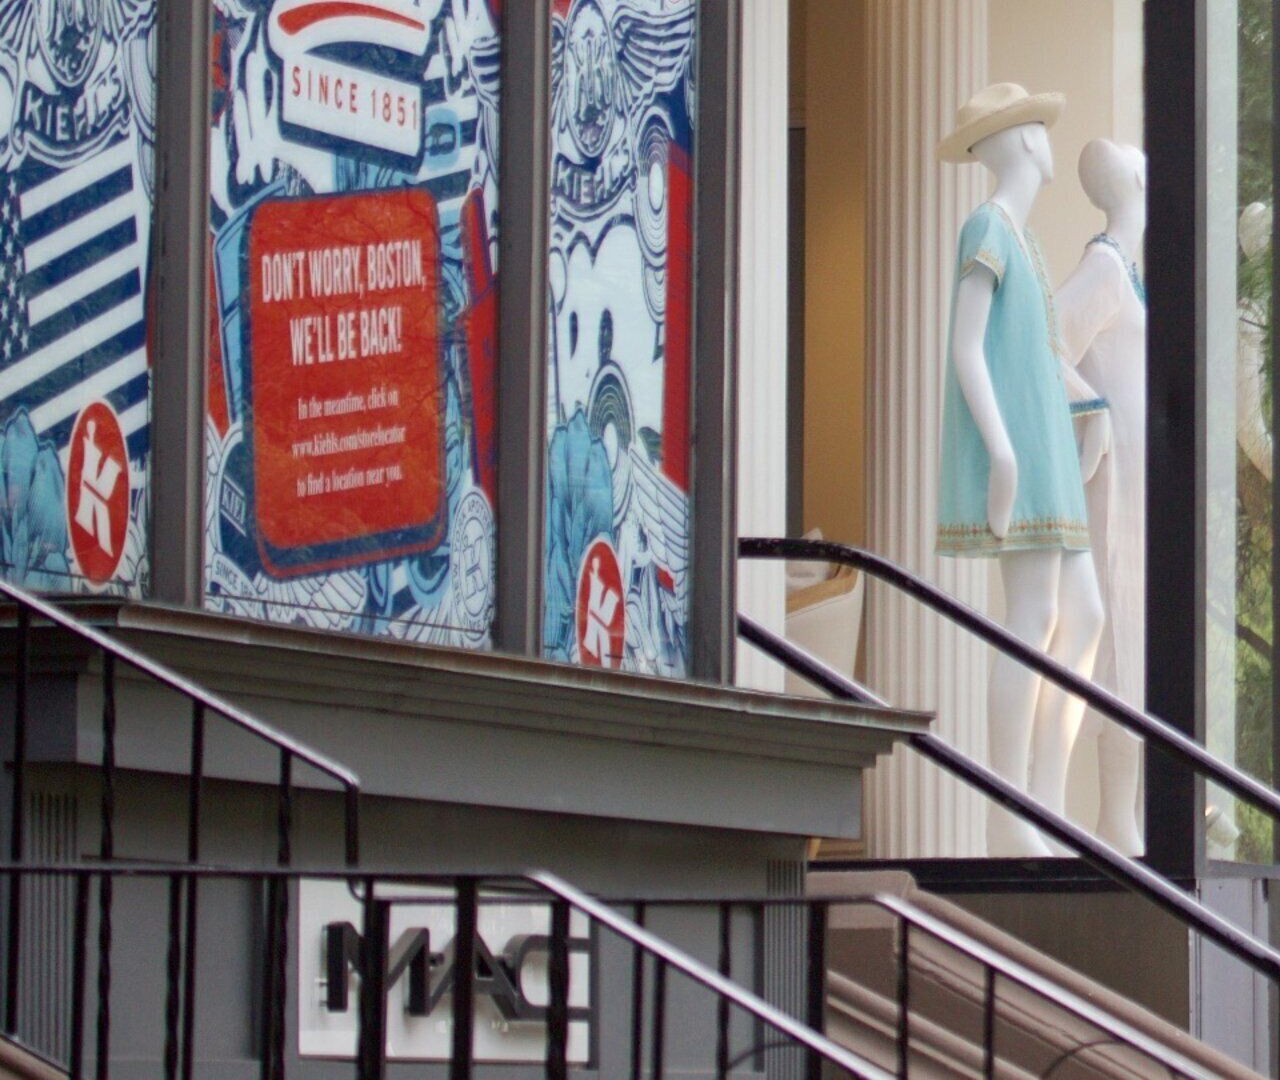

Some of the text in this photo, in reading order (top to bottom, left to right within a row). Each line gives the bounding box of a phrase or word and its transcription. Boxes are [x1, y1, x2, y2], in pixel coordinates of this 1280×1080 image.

[291, 66, 418, 130] SINCE 1851
[261, 239, 427, 303] DON'T WORRY, BOSTON,
[289, 306, 402, 366] WE'LL BE BACK!
[298, 397, 308, 420] In
[309, 396, 322, 418] the
[387, 389, 399, 407] on
